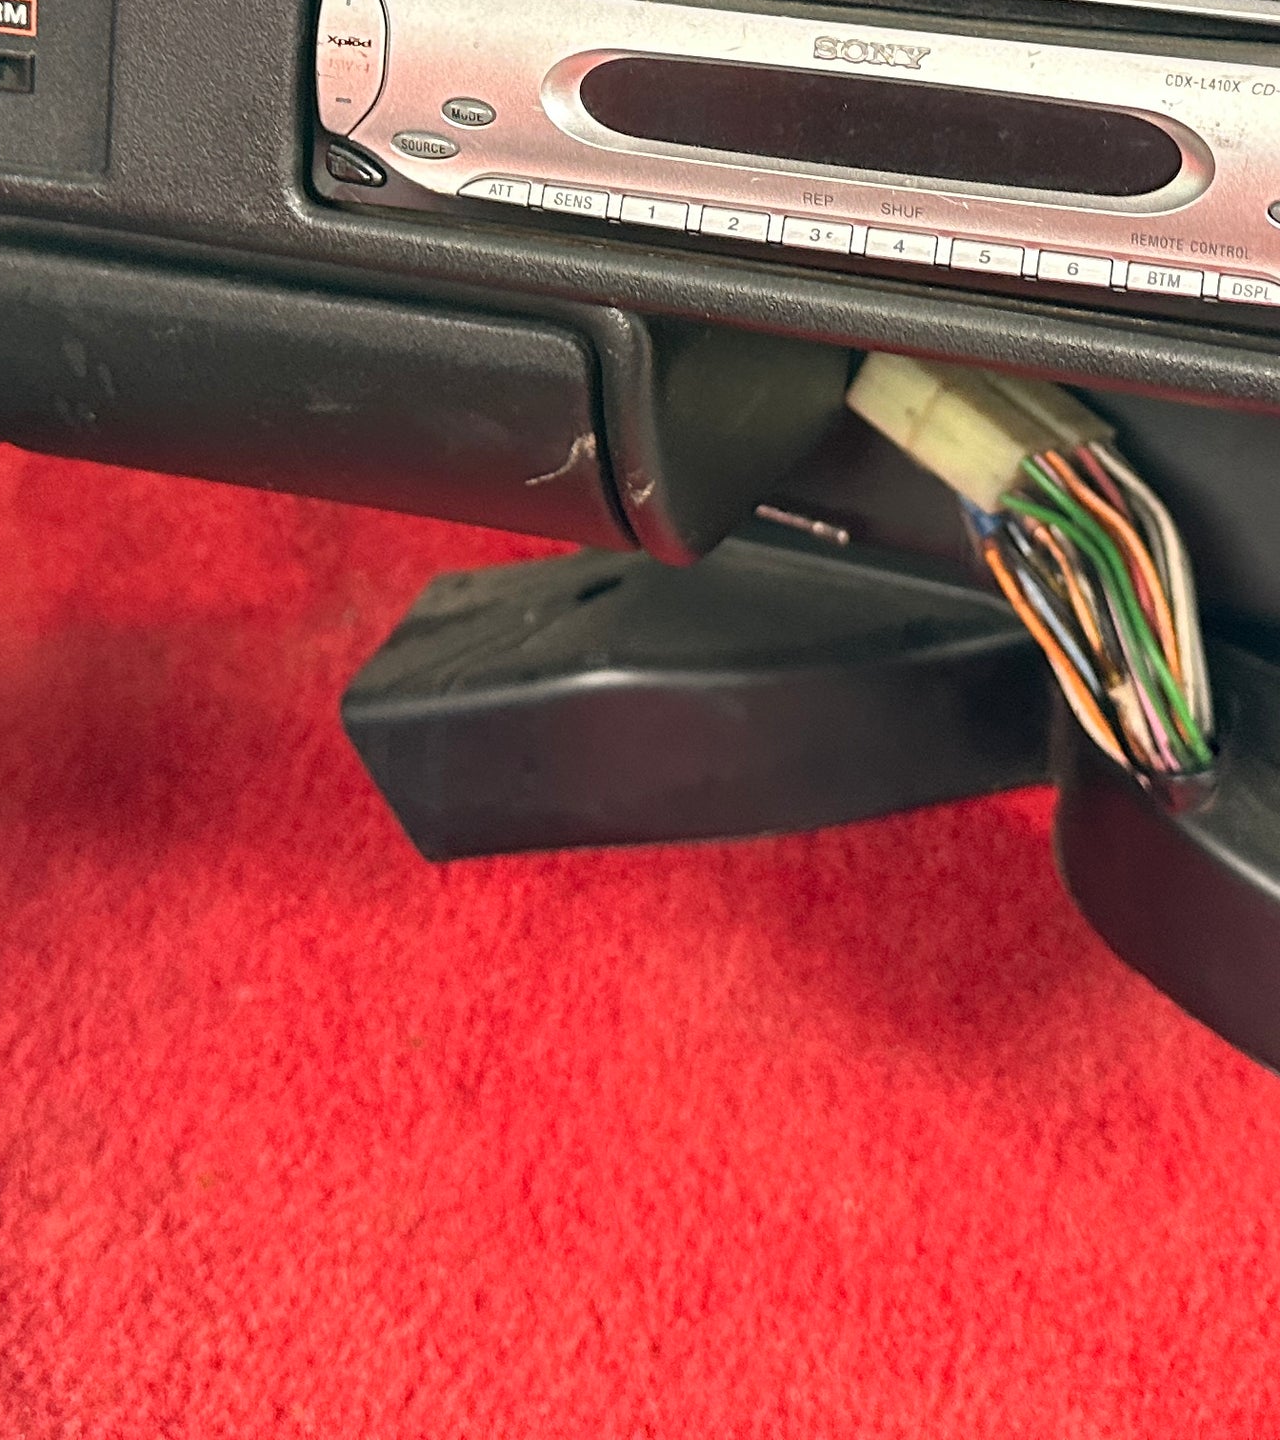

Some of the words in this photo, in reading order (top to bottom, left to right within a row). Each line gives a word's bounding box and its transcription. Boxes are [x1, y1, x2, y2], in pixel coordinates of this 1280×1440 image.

[813, 36, 931, 70] SONY
[1165, 74, 1241, 93] CDX-L410X
[401, 138, 446, 155] SOURCE
[488, 183, 514, 198] ATT
[553, 192, 593, 210] SENS
[803, 192, 834, 207] REP
[648, 206, 655, 220] 1
[881, 202, 924, 219] SHUF
[727, 217, 741, 232] 2
[893, 239, 905, 253] 4
[1131, 232, 1183, 251] REMOTE
[1190, 241, 1250, 260] CONTROL
[978, 250, 992, 265] 5
[1066, 262, 1080, 277] 6
[1147, 271, 1181, 288] BTM
[1232, 282, 1272, 300] DSPL
